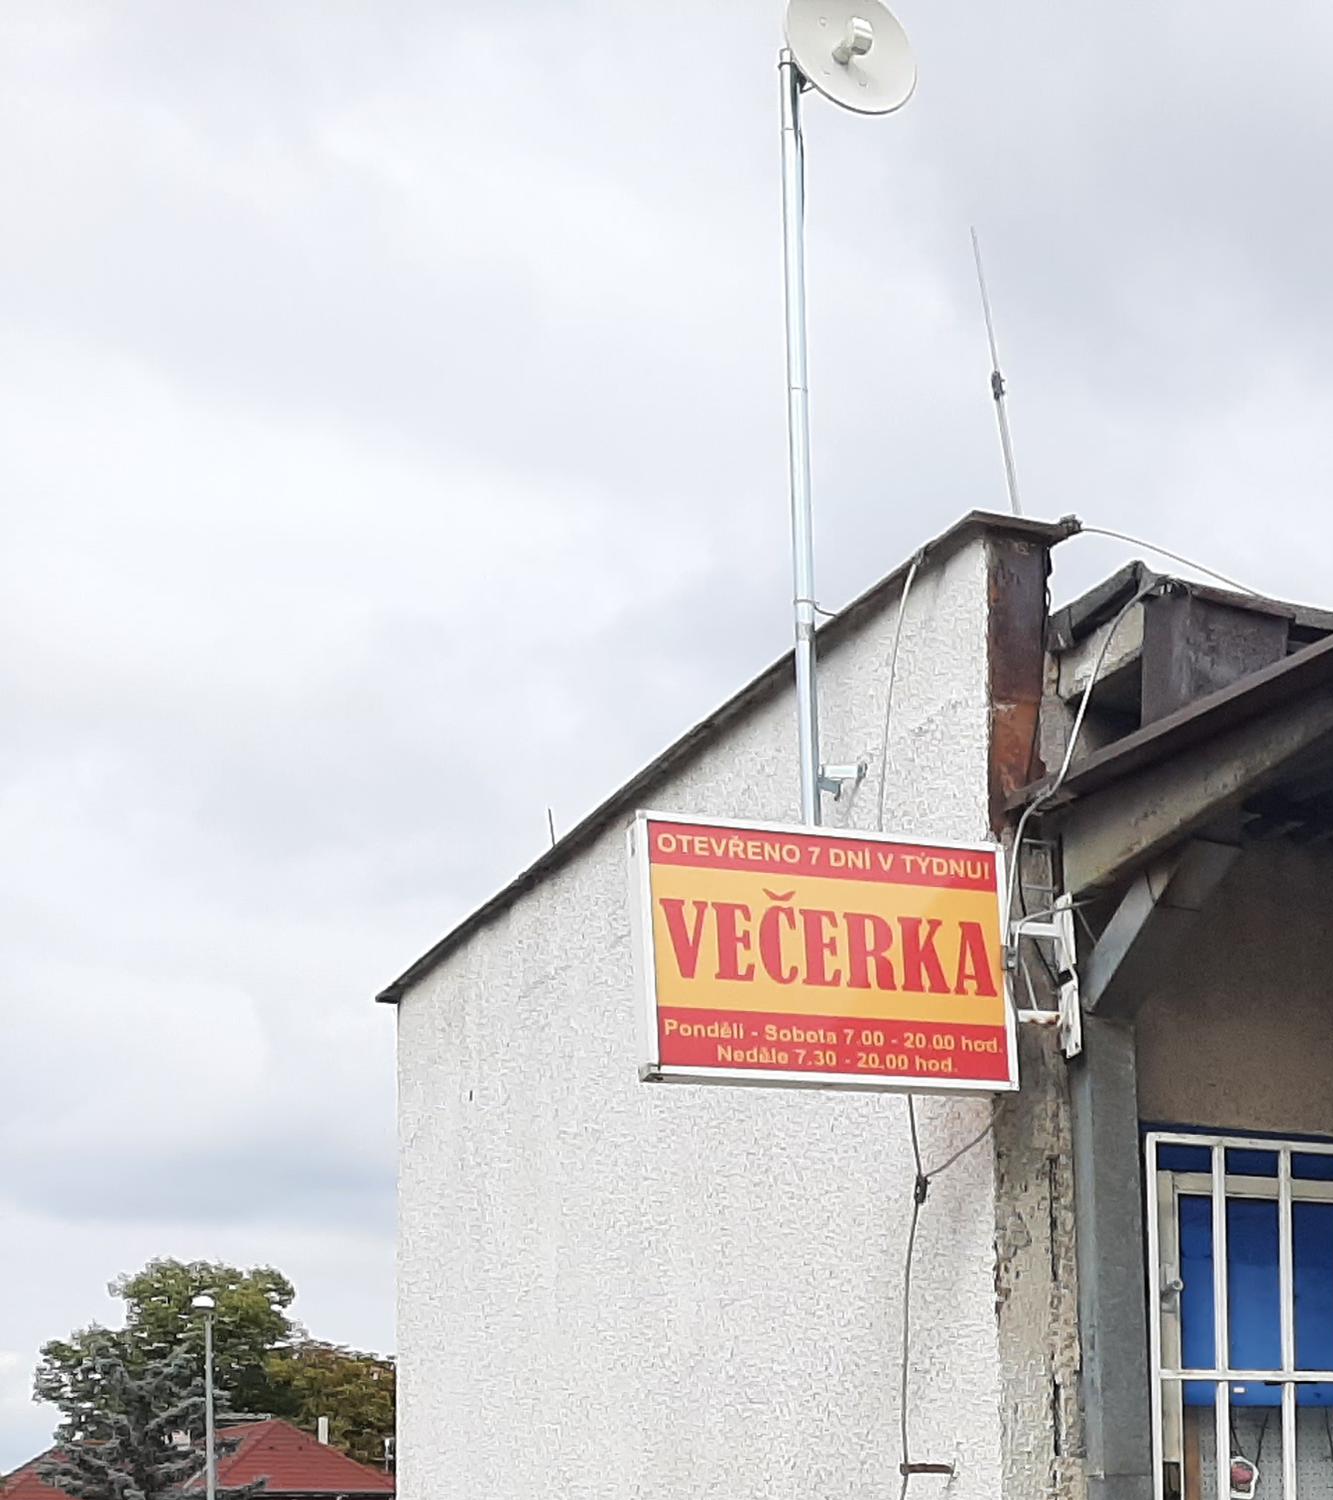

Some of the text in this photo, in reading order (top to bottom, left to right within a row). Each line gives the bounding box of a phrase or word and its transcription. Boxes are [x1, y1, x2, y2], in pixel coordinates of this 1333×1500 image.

[657, 833, 801, 864] OTEVŘENO
[807, 847, 821, 865] 7
[829, 848, 871, 870] DNÍ
[877, 852, 894, 871] V
[659, 888, 997, 998] VEČERKA
[765, 1024, 837, 1044] Sobota
[843, 1029, 884, 1047] 7.00
[903, 1032, 955, 1051] 20.00
[794, 1049, 837, 1067] 7.30
[857, 1052, 909, 1070] 20.00
